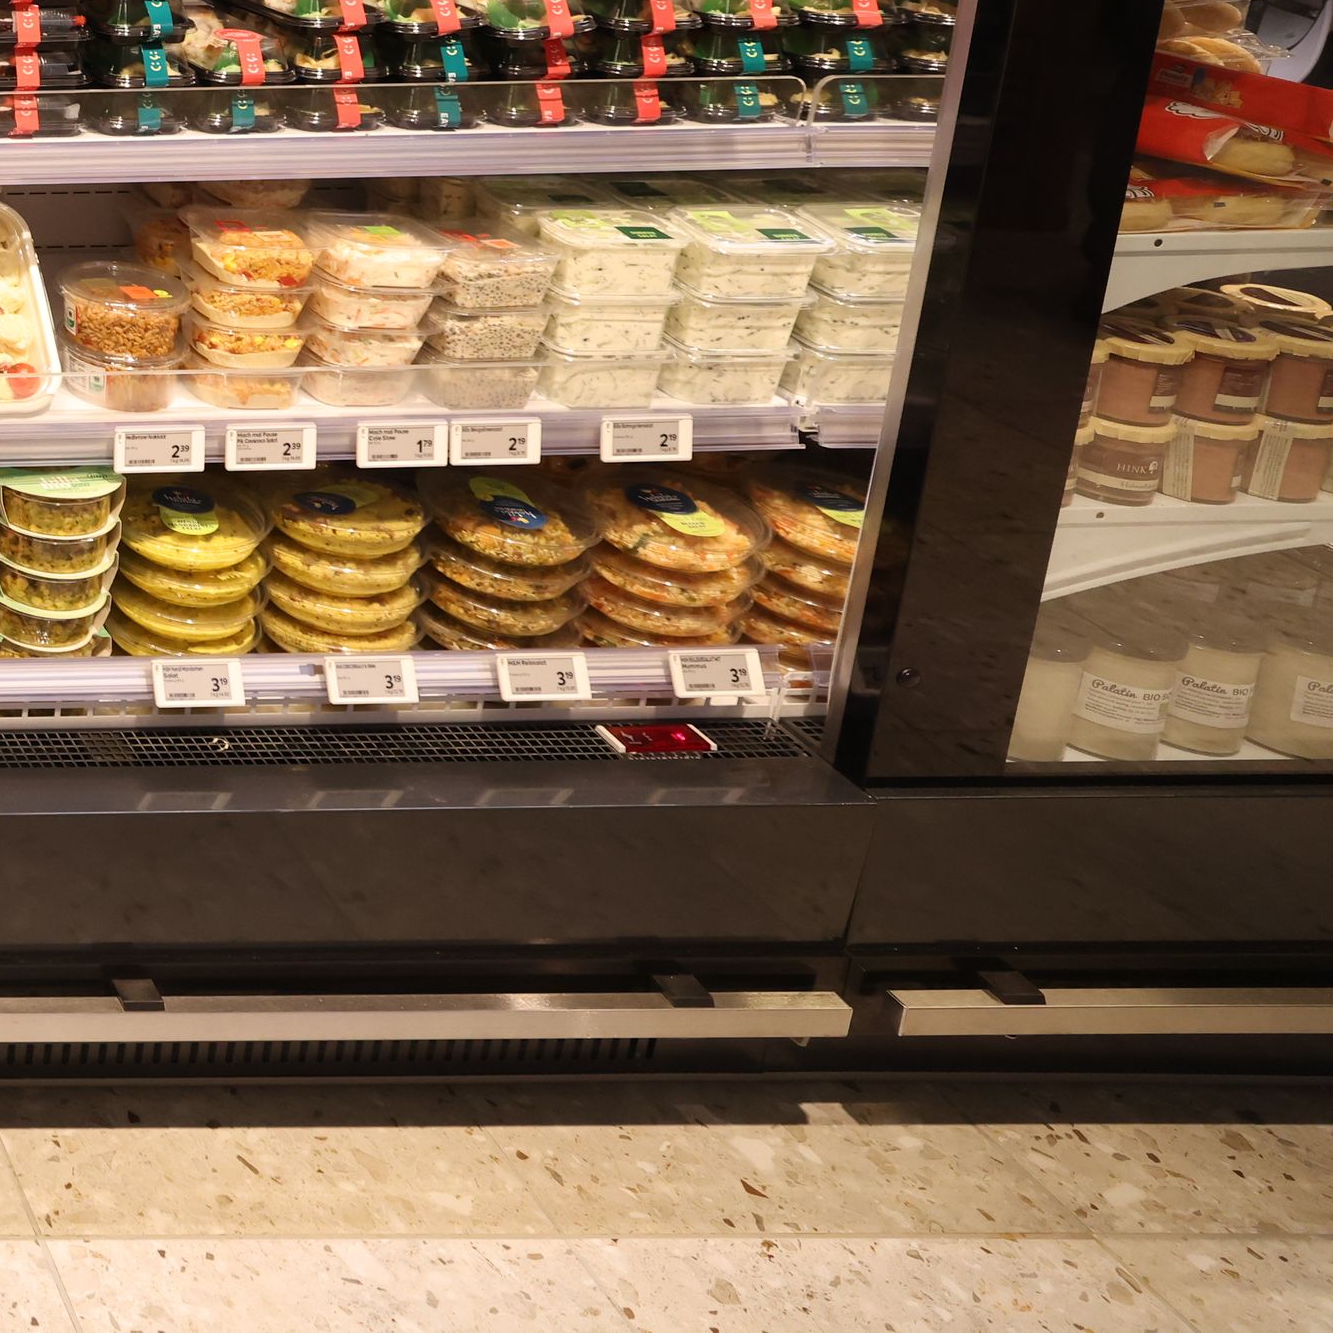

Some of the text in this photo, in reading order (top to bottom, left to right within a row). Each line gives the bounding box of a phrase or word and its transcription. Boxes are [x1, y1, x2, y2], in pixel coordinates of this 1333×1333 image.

[1117, 462, 1147, 476] HINK
[1091, 678, 1138, 700] Palatin
[1181, 675, 1228, 695] Palatin
